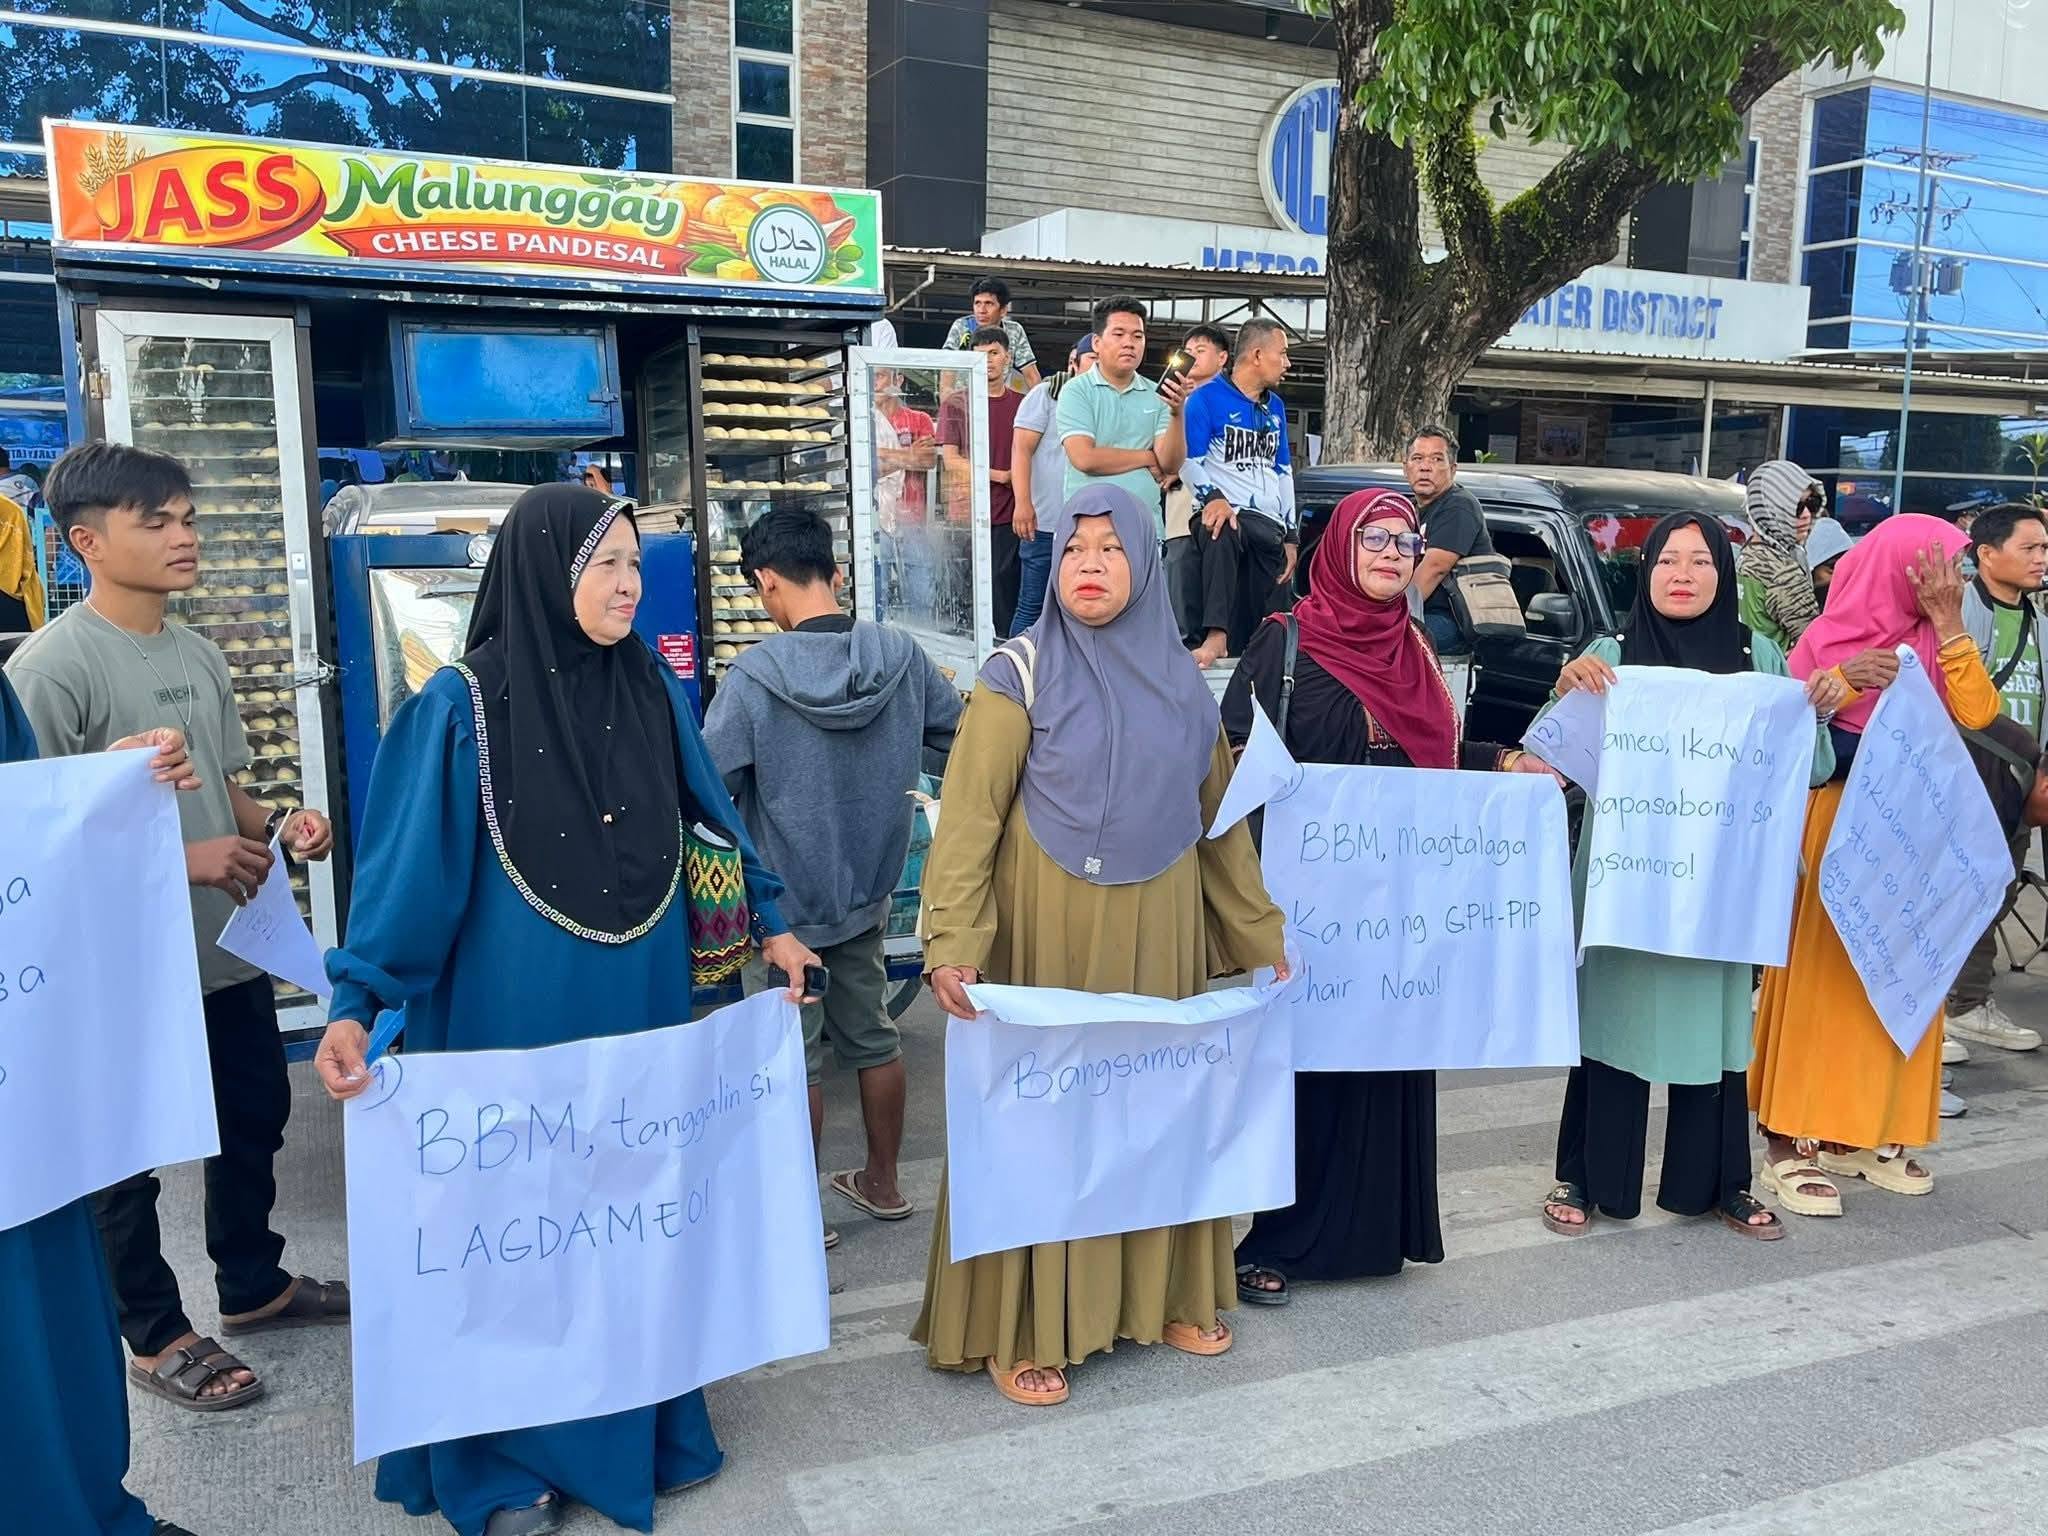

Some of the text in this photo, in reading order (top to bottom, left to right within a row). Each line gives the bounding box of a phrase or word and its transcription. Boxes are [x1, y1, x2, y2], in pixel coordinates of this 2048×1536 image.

[101, 154, 679, 241] JASS Malunggay
[372, 231, 666, 269] CHEESE PANDESAL
[760, 224, 816, 252] حلال
[769, 255, 810, 270] HALAL
[1520, 284, 1592, 329] ATER
[1602, 288, 1723, 340] DISTRICT
[1602, 733, 1669, 756] ameo,
[1300, 821, 1386, 865] BBM,
[1445, 900, 1542, 935] GPH-PIP
[1288, 960, 1442, 1003] hair Now!
[1002, 1027, 1234, 1101] Bangsamoro!
[416, 1067, 772, 1176] BBM, tanggalin si
